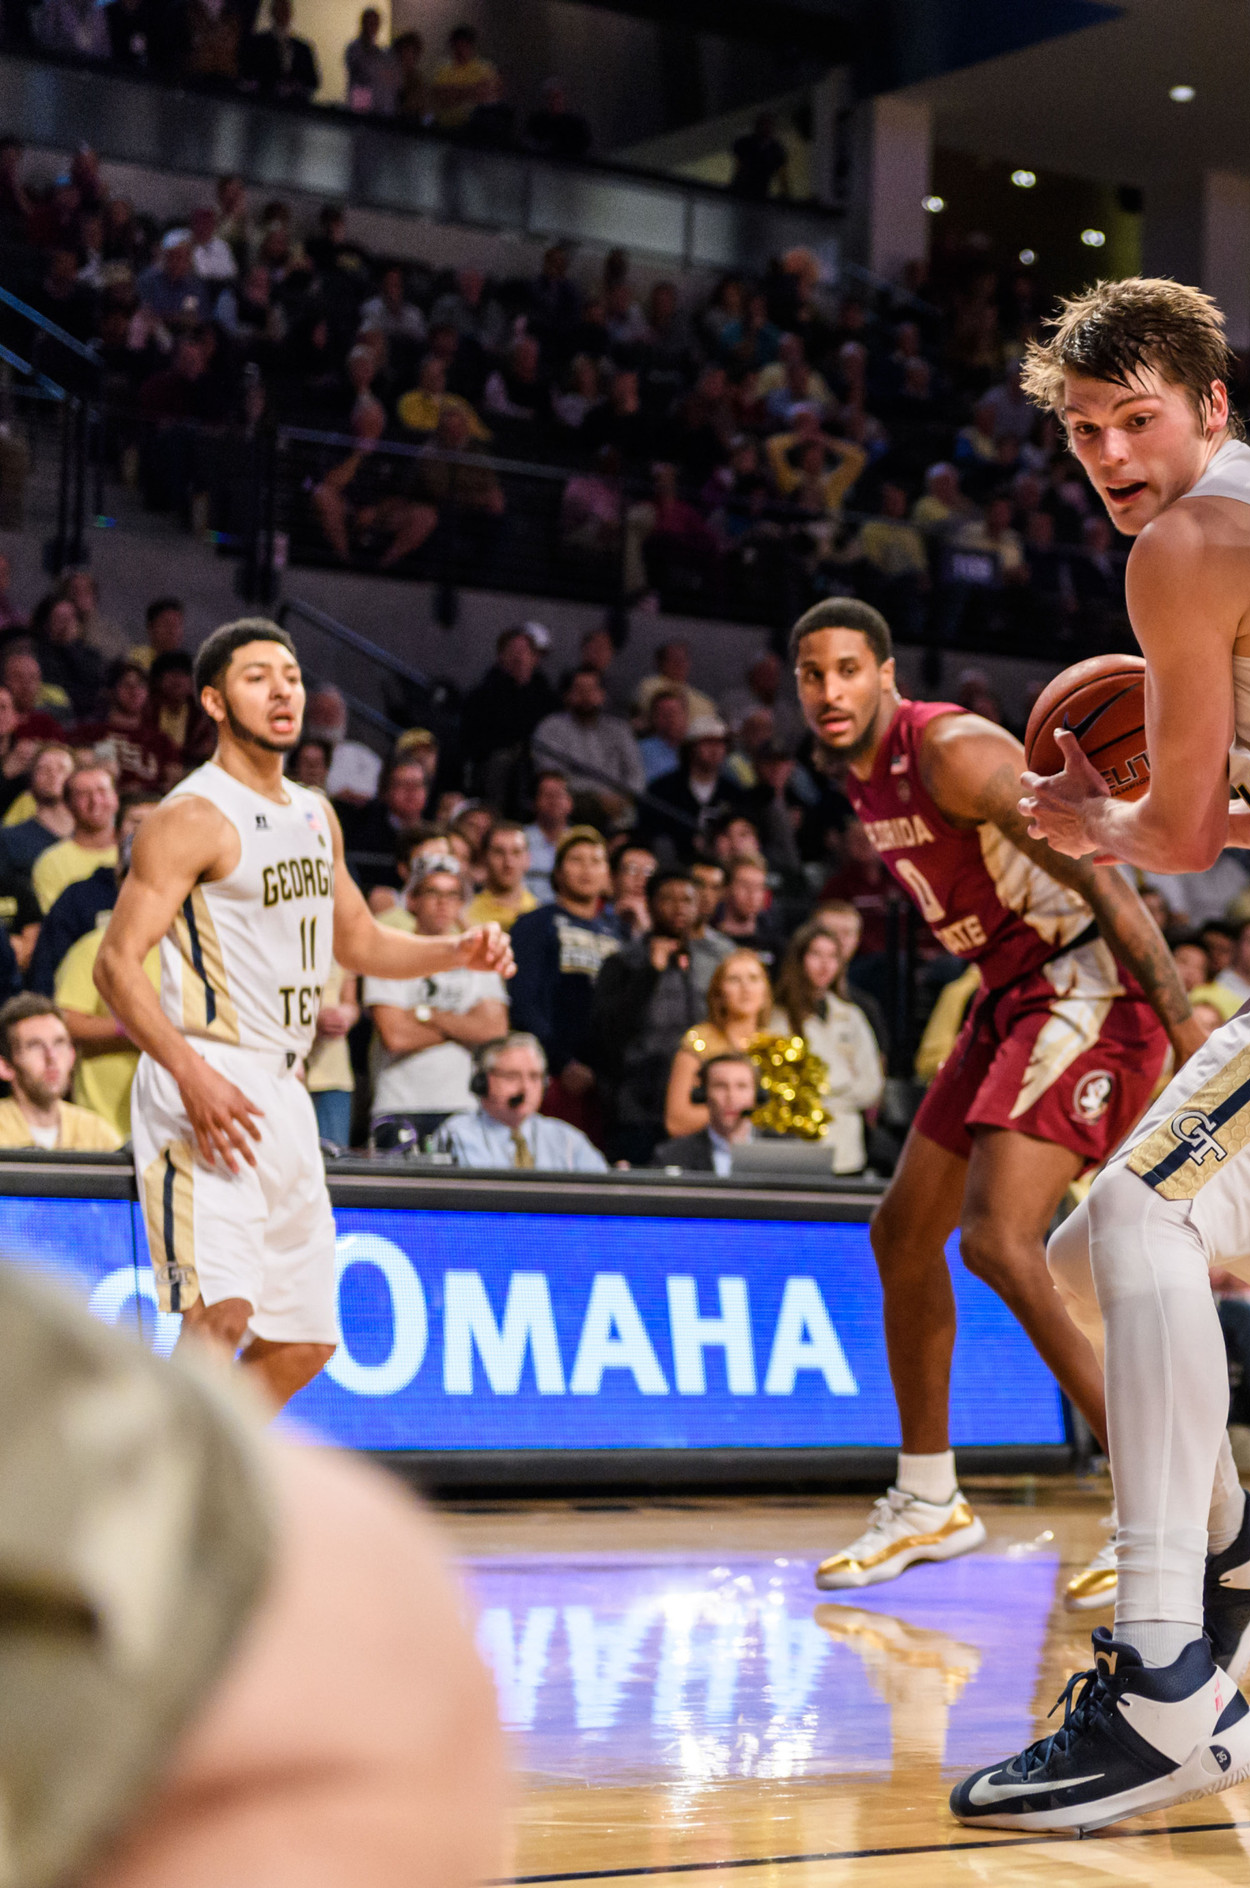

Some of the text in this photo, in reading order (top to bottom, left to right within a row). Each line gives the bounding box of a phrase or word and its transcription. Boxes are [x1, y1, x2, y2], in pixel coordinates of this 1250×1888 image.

[1100, 750, 1151, 790] ELIT
[262, 857, 334, 908] GEORGI
[301, 916, 317, 971] 11
[323, 1232, 860, 1396] OMAHA
